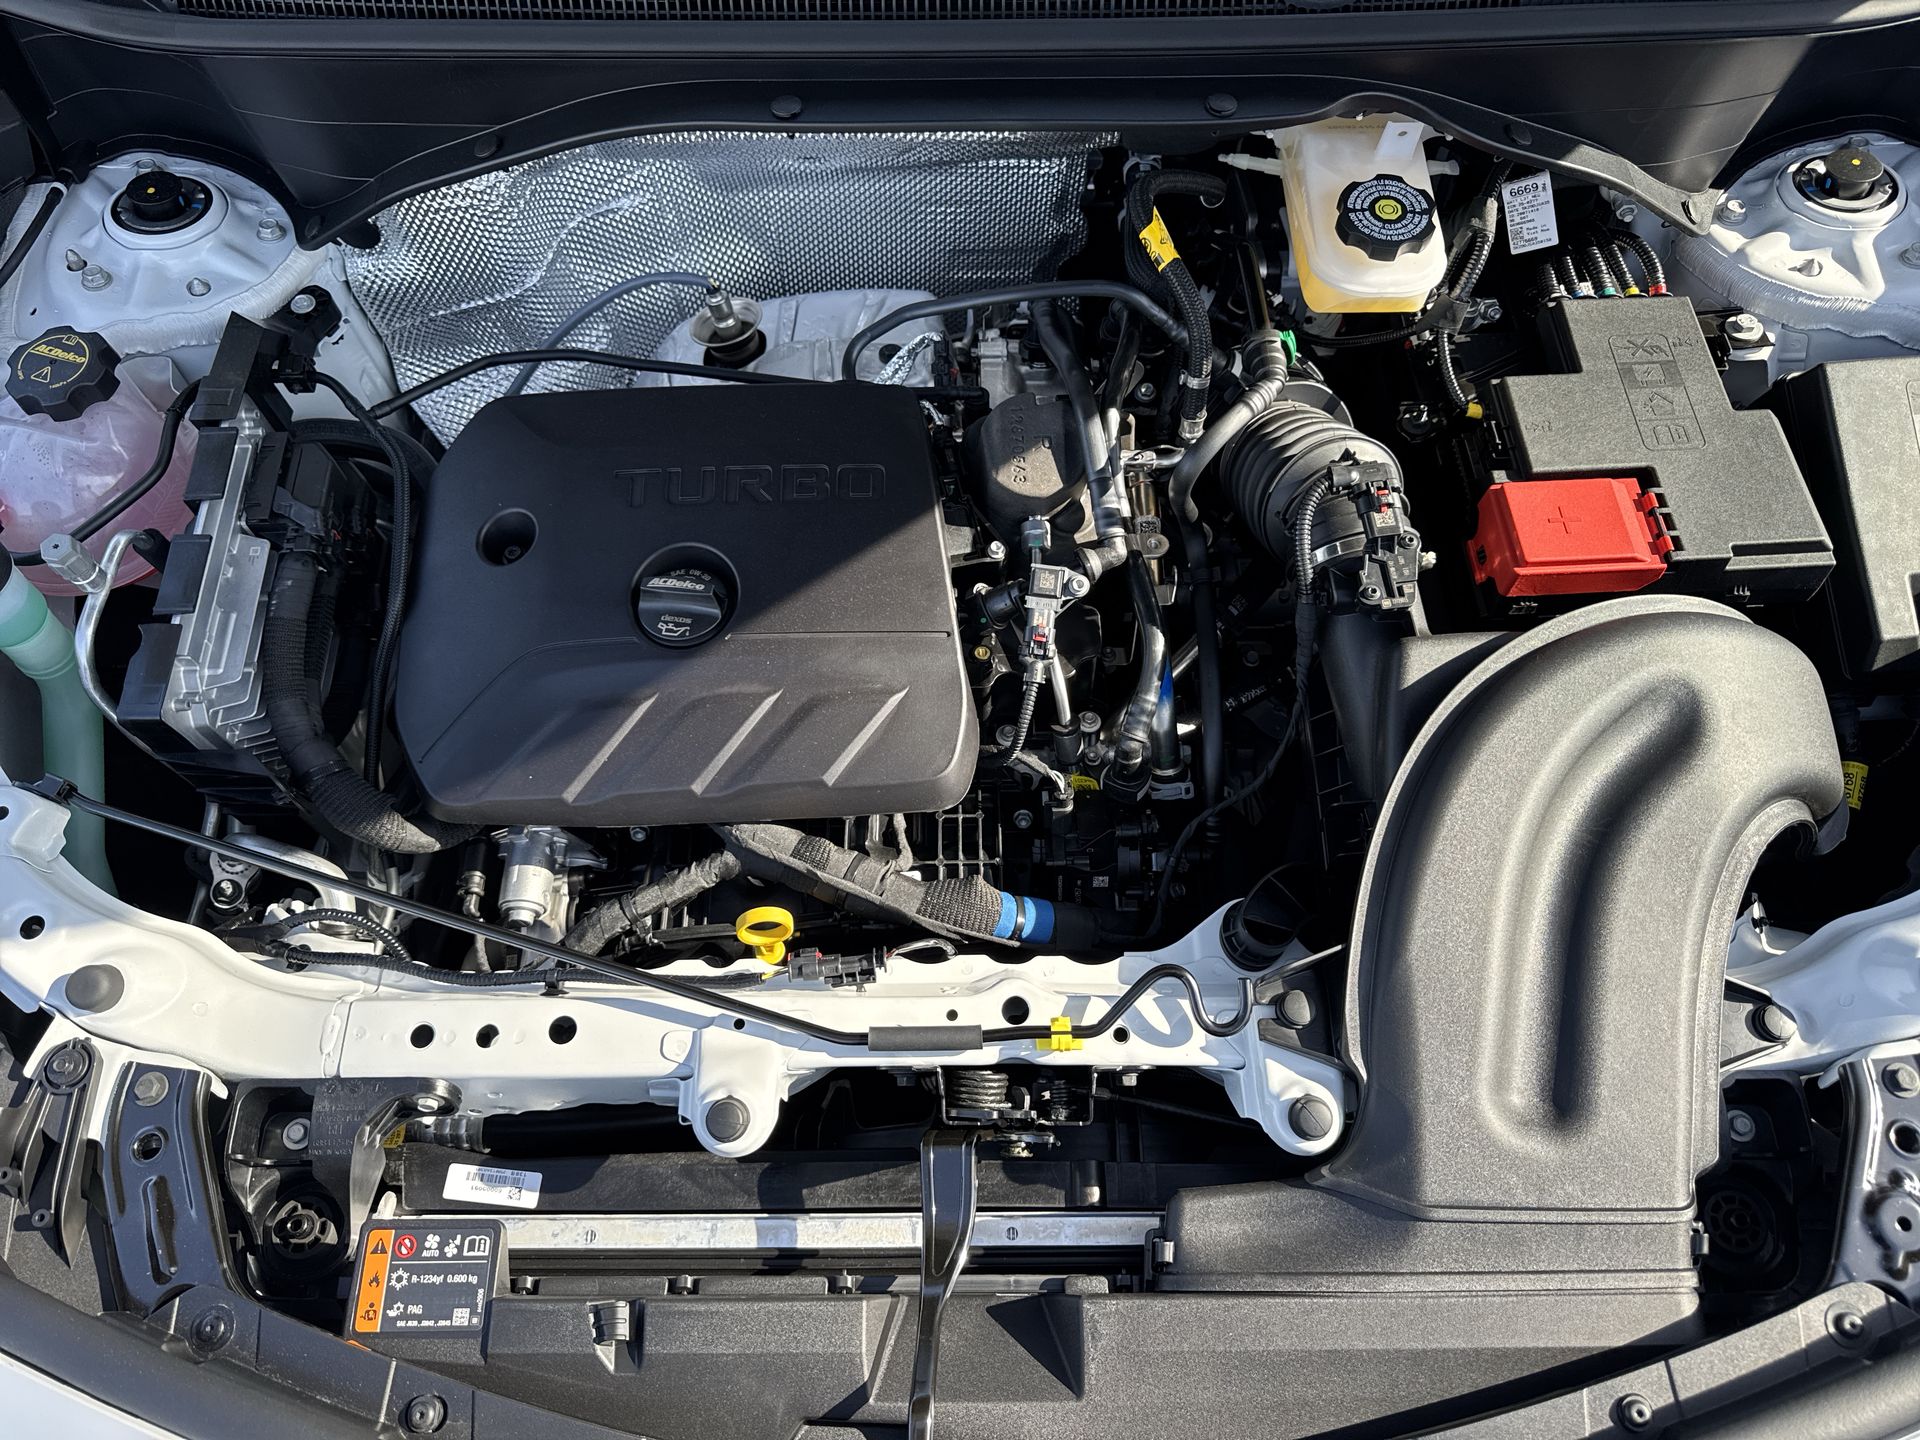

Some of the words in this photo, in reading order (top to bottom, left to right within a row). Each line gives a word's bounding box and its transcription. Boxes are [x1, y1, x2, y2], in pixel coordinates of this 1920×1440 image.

[1510, 183, 1538, 196] 6669
[34, 344, 86, 363] ACDelco
[614, 464, 886, 508] TURBO
[647, 578, 705, 591] ACDelco
[661, 614, 693, 623] dexos
[411, 1274, 444, 1285] R-1234yf
[447, 1274, 467, 1283] 0.600
[468, 1274, 478, 1284] kg
[408, 1304, 423, 1314] PAG
